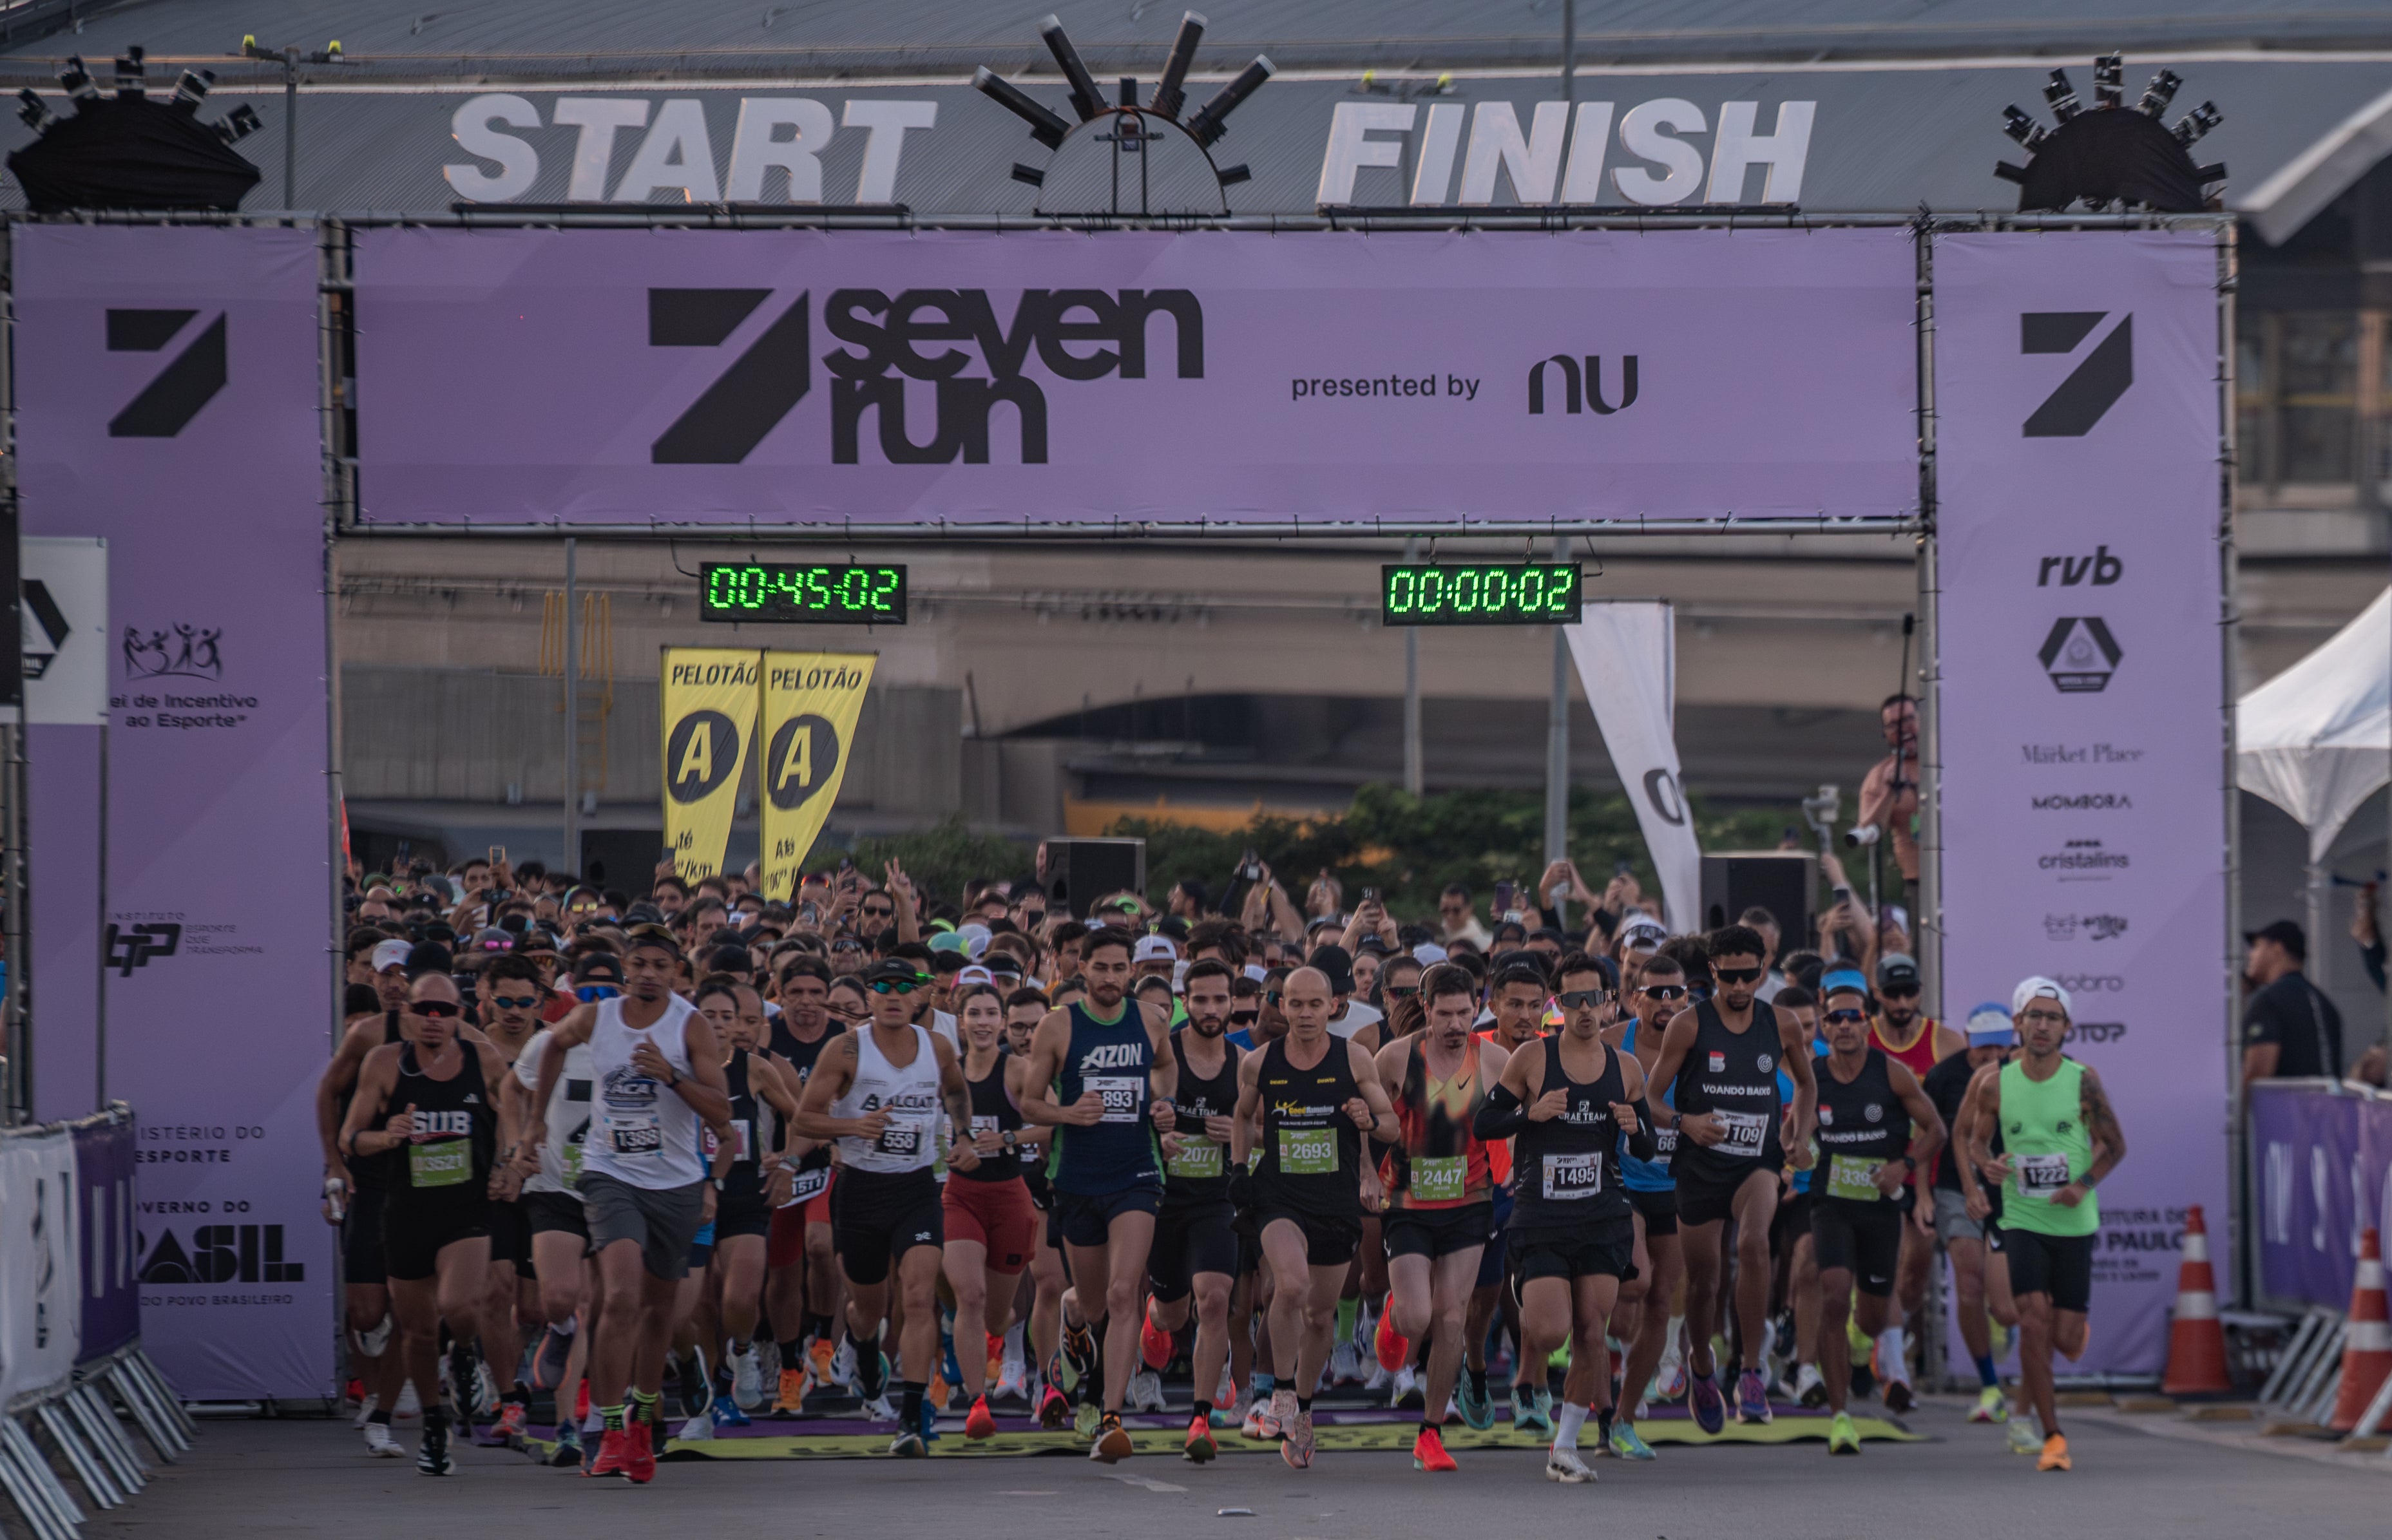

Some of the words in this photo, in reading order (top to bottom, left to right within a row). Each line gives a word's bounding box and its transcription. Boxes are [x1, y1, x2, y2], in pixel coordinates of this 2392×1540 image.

[444, 93, 939, 204] START
[1316, 98, 1817, 205] FINISH
[822, 289, 1204, 381] seven
[1292, 374, 1436, 401] presented
[1448, 374, 1480, 400] by
[830, 377, 1048, 464] run
[2036, 545, 2124, 587] rvb
[709, 567, 899, 611] 00:45:02
[1390, 569, 1573, 613] 00:00:02
[672, 661, 758, 686] PELOTÃO
[771, 665, 862, 690] PELOTÃO
[110, 694, 128, 708] ei
[133, 694, 159, 708] de
[164, 693, 259, 708] Incentivo
[125, 715, 151, 727] ao
[676, 721, 712, 784] A
[777, 725, 812, 791] A
[1078, 1043, 1143, 1070] AZON
[1102, 1091, 1133, 1107] 893
[1703, 1083, 1745, 1095] VOANDO
[1746, 1086, 1771, 1096] BAIXO
[411, 1111, 472, 1136] SUB
[1583, 1112, 1607, 1121] TEAM
[140, 1124, 225, 1140] ISTÉRIO
[235, 1126, 266, 1139] DO
[883, 1132, 916, 1150] 558
[1182, 1146, 1218, 1163] 2077
[1292, 1142, 1332, 1159] 2693
[1423, 1168, 1462, 1186] 2447
[1558, 1167, 1596, 1184] 1495
[2028, 1166, 2068, 1184] 1222
[137, 1201, 211, 1213] VERNO
[222, 1200, 253, 1213] DO
[137, 1224, 305, 1283] ASIL
[167, 1296, 207, 1306] POVO
[212, 1294, 293, 1305] BRASILEIRO
